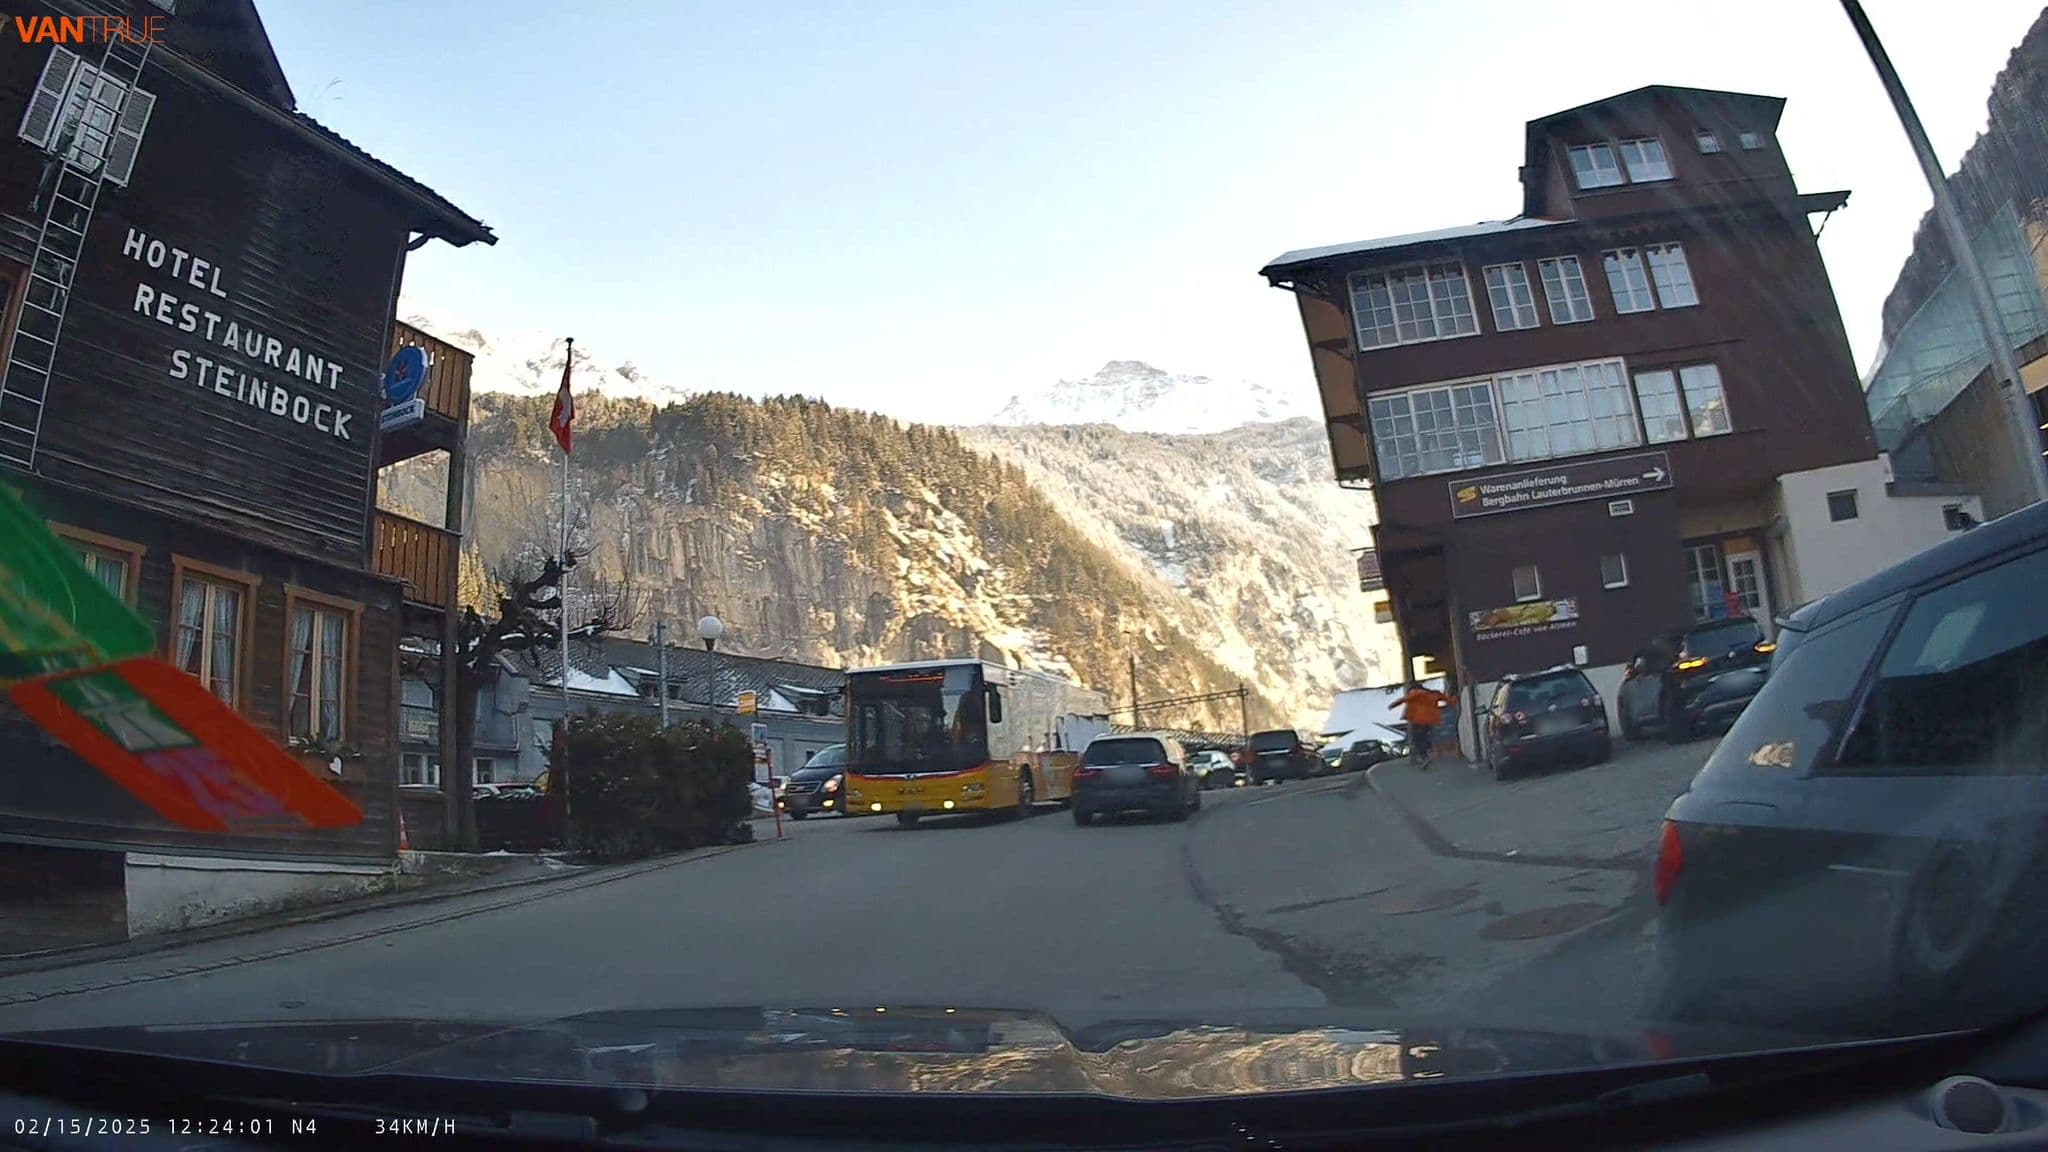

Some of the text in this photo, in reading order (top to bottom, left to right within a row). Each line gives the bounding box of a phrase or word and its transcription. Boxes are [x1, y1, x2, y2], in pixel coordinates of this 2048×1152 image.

[122, 228, 227, 298] HOTEL
[133, 283, 344, 390] RESTAURANT
[169, 350, 352, 440] STEINBOCK
[1479, 474, 1567, 494] Warenanlieferung
[1482, 476, 1640, 507] Bergbahn Lauterbrunnen-Mürren
